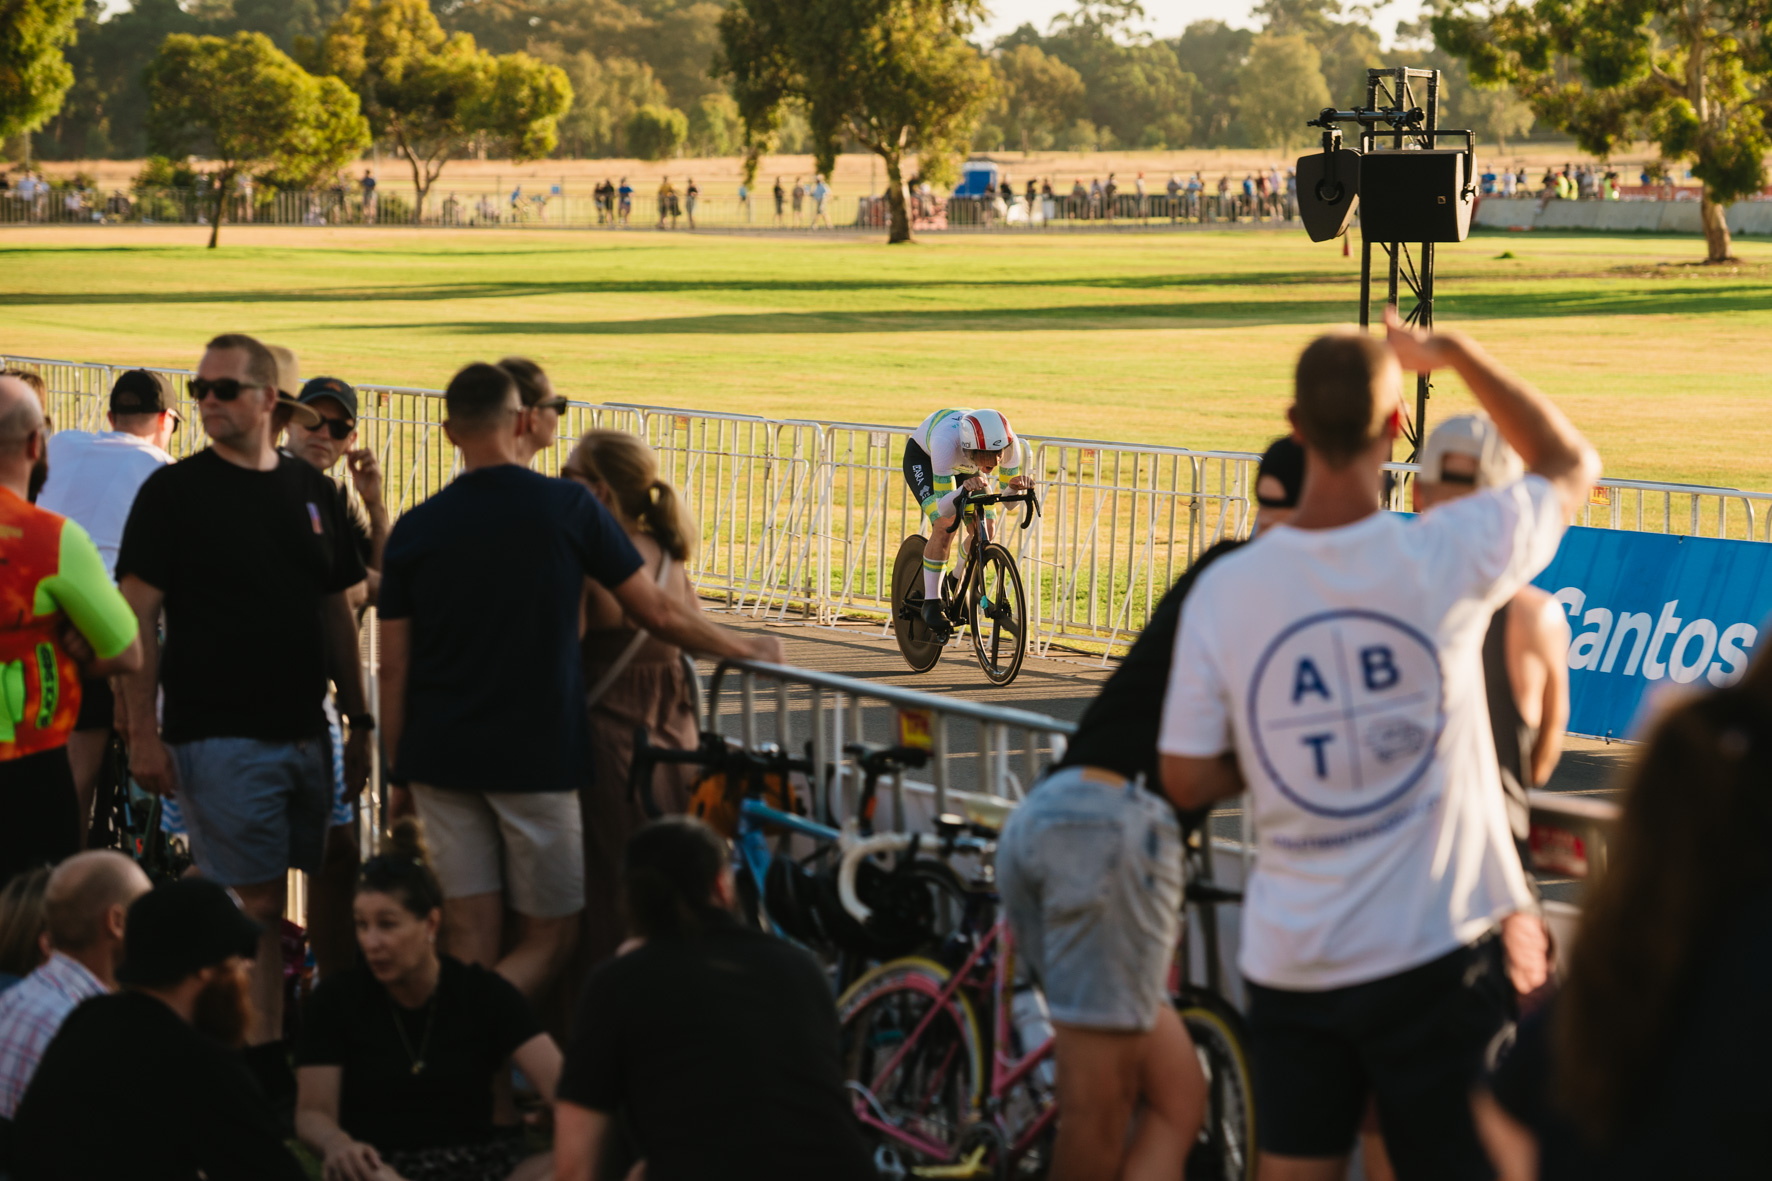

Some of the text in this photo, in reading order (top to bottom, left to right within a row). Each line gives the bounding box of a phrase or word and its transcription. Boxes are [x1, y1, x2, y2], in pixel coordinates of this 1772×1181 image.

[1293, 645, 1402, 705] A B
[1302, 733, 1335, 780] T
